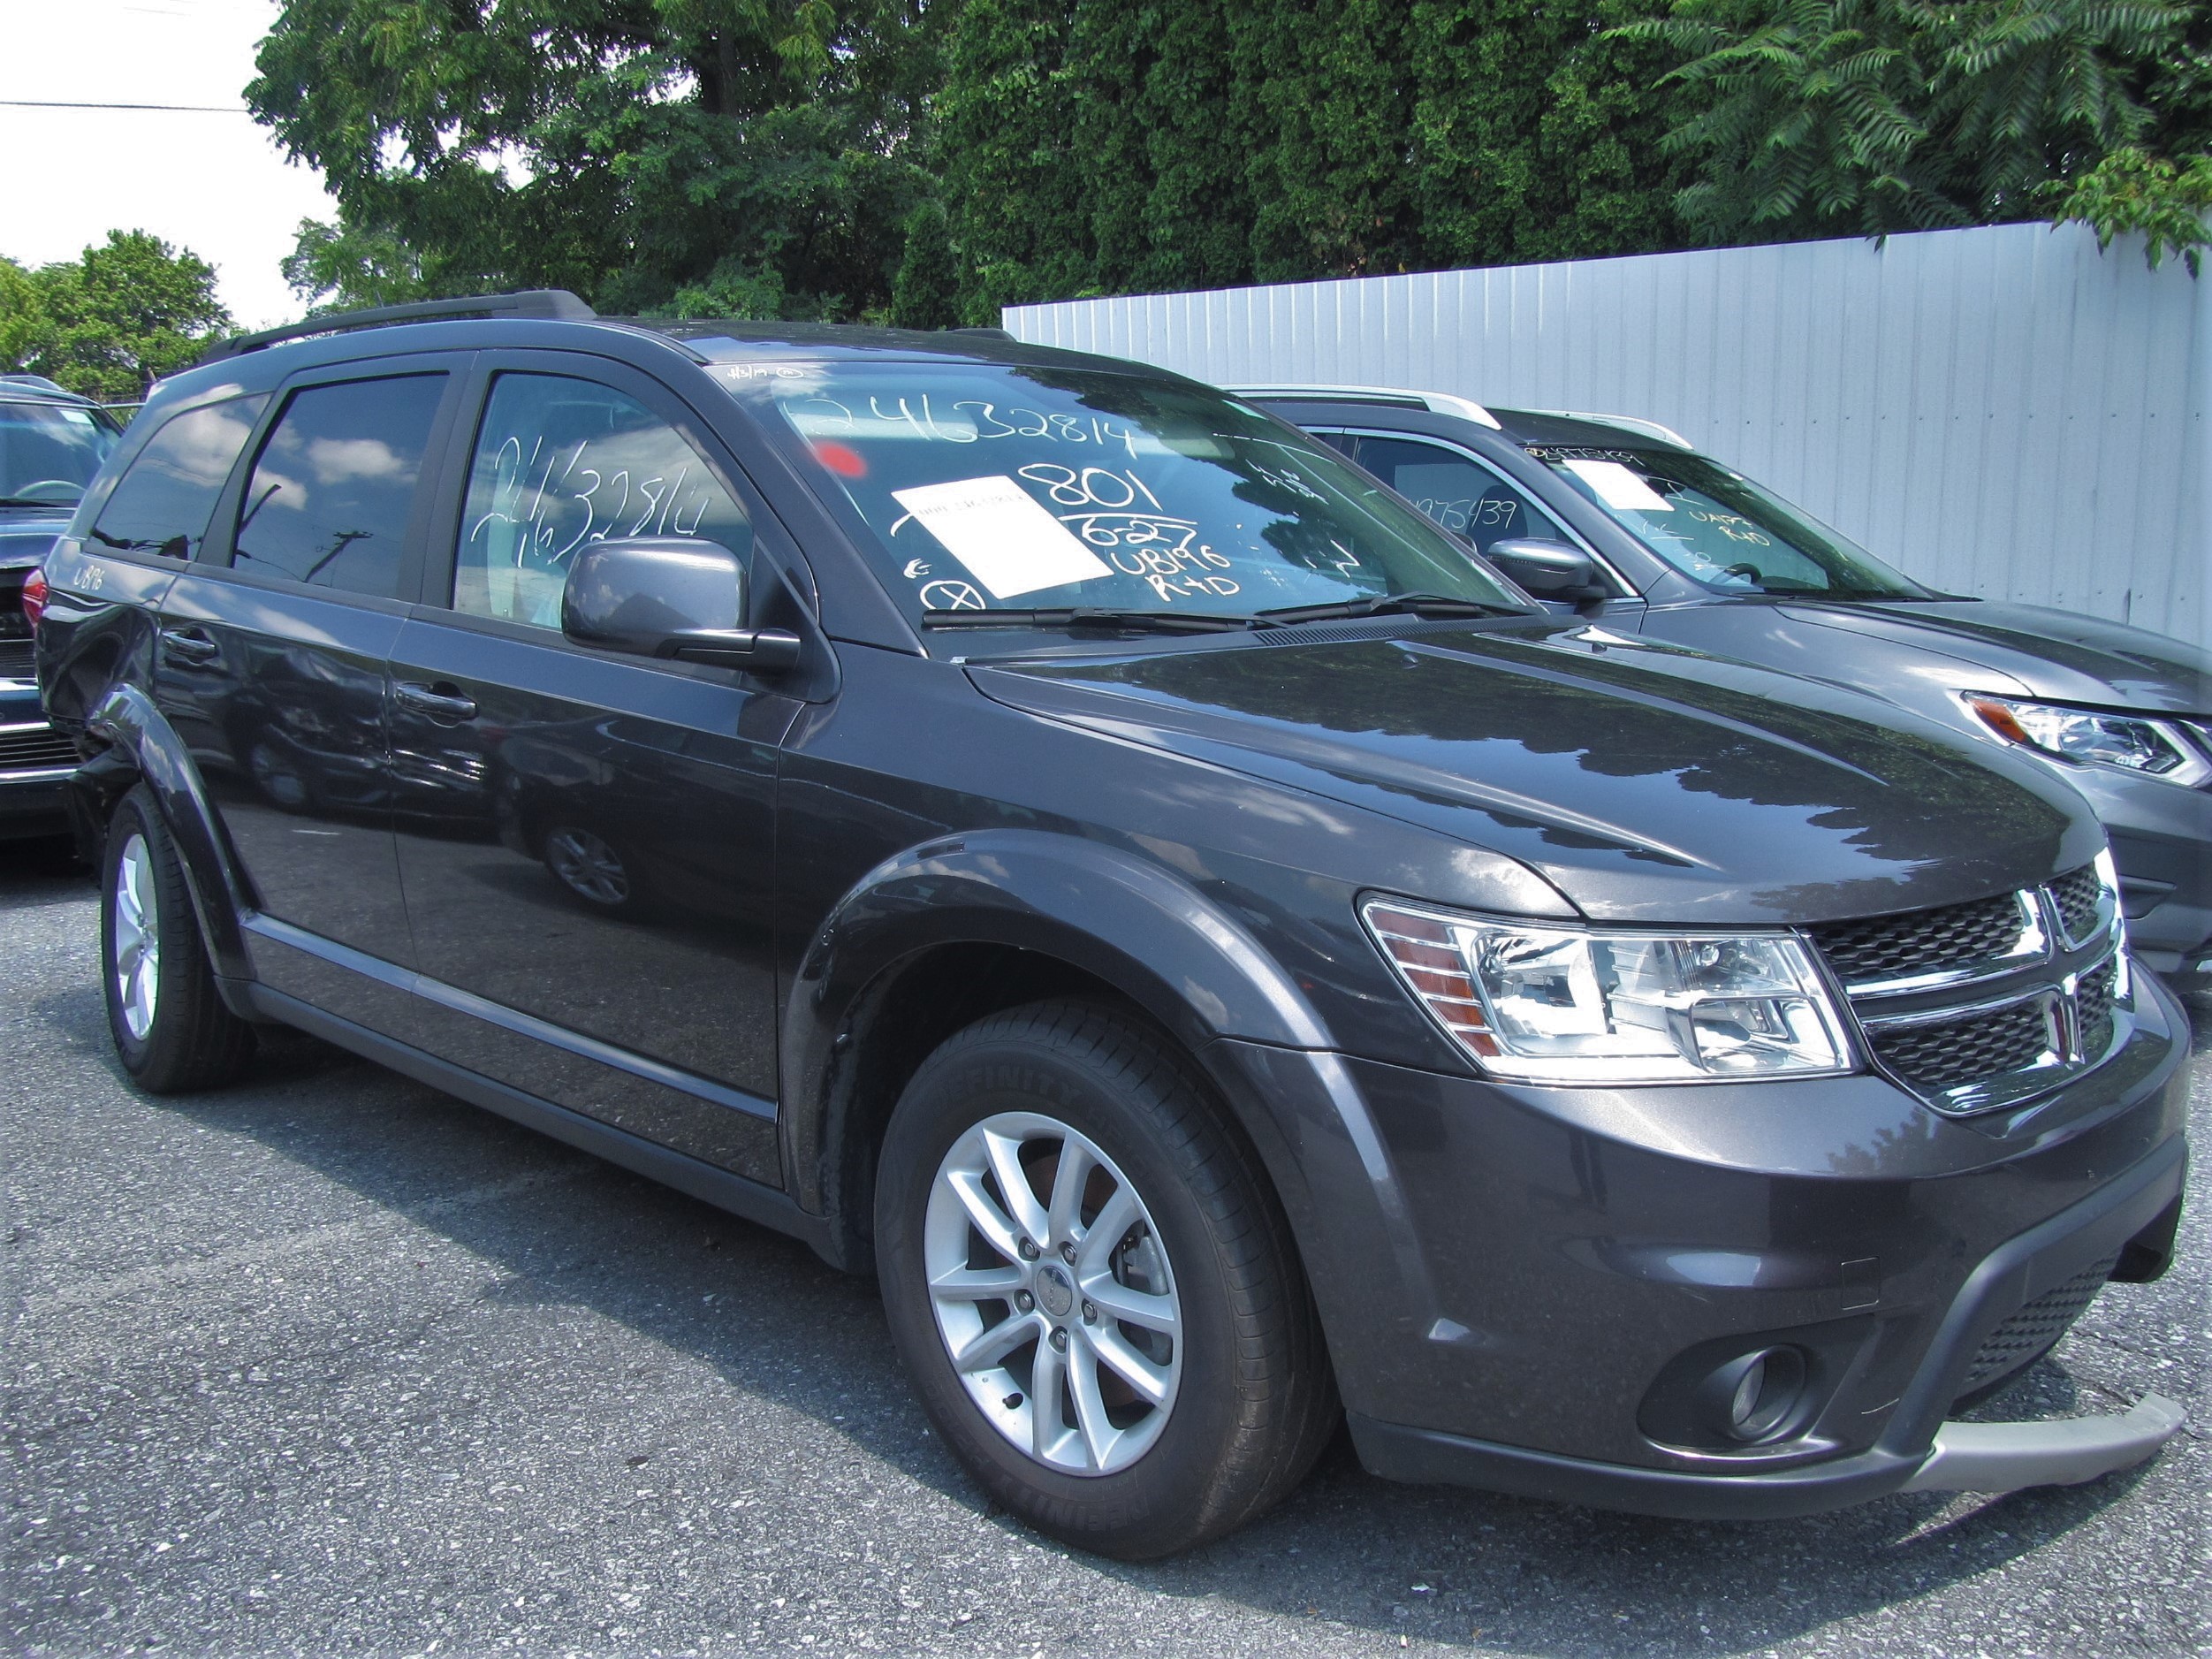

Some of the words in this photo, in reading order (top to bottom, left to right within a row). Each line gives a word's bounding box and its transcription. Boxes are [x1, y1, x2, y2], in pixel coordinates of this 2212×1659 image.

[803, 392, 1139, 460] 24632814
[1016, 461, 1165, 513] 801
[1109, 544, 1232, 575] UB196
